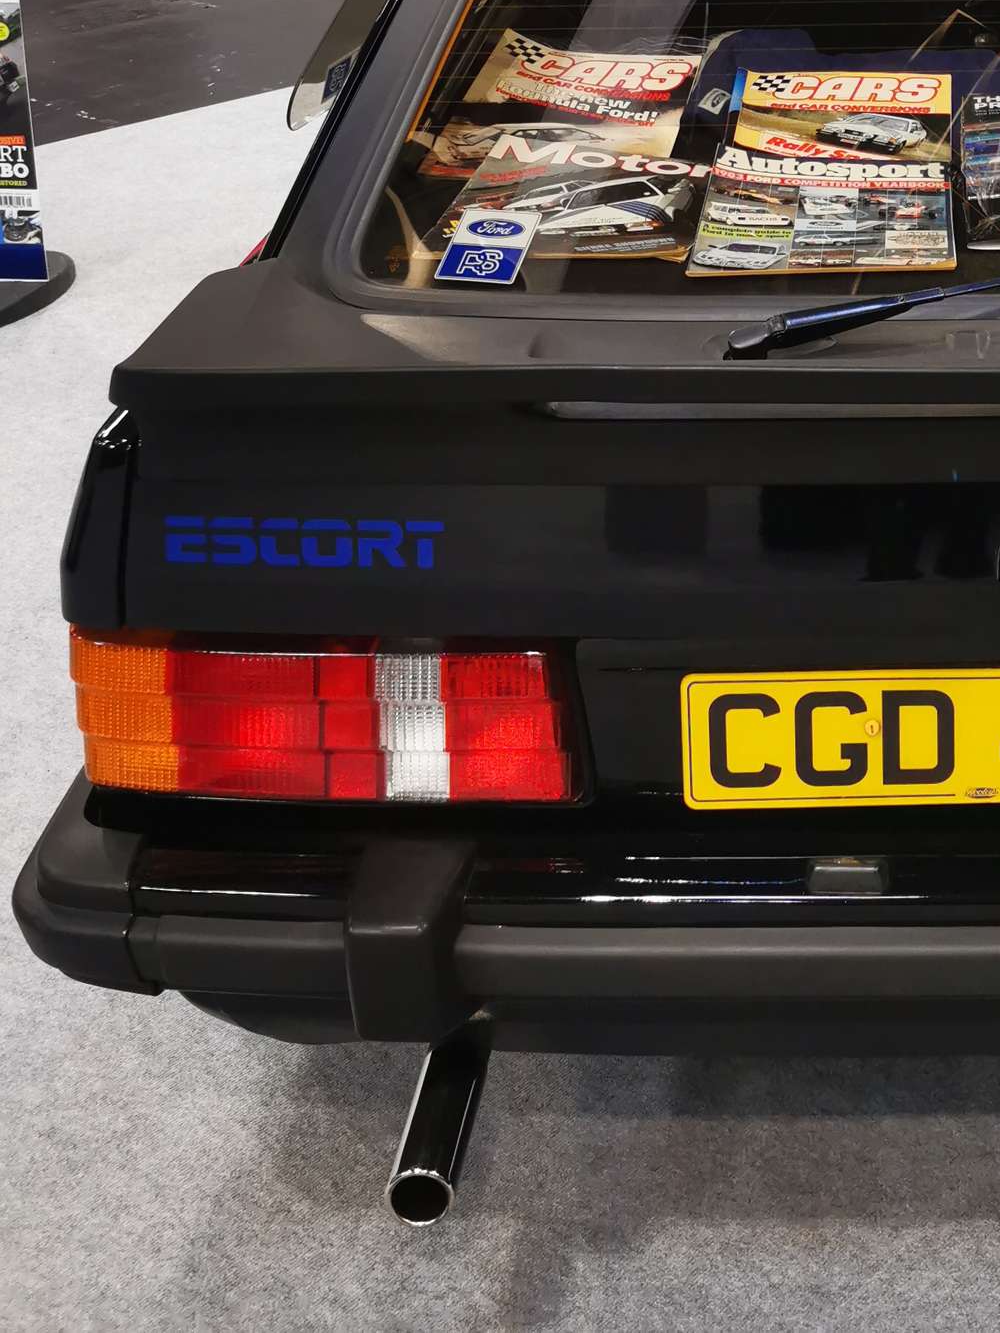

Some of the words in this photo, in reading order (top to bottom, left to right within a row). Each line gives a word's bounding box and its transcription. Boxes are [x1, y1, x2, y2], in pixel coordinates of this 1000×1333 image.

[521, 55, 692, 93] CARS
[543, 77, 572, 89] CAR
[774, 76, 942, 103] CARS
[597, 105, 659, 122] Ford!
[831, 104, 930, 114] CONVERSIONS
[488, 135, 714, 177] Motor
[767, 137, 826, 157] Rally
[718, 147, 945, 181] Autosport
[747, 175, 781, 186] FORD
[783, 178, 873, 189] COMPETITION
[874, 180, 946, 189] YEARBOOK
[477, 221, 514, 235] Ford
[456, 249, 503, 276] RS
[165, 517, 444, 569] ESCORT
[708, 690, 955, 788] CGD
